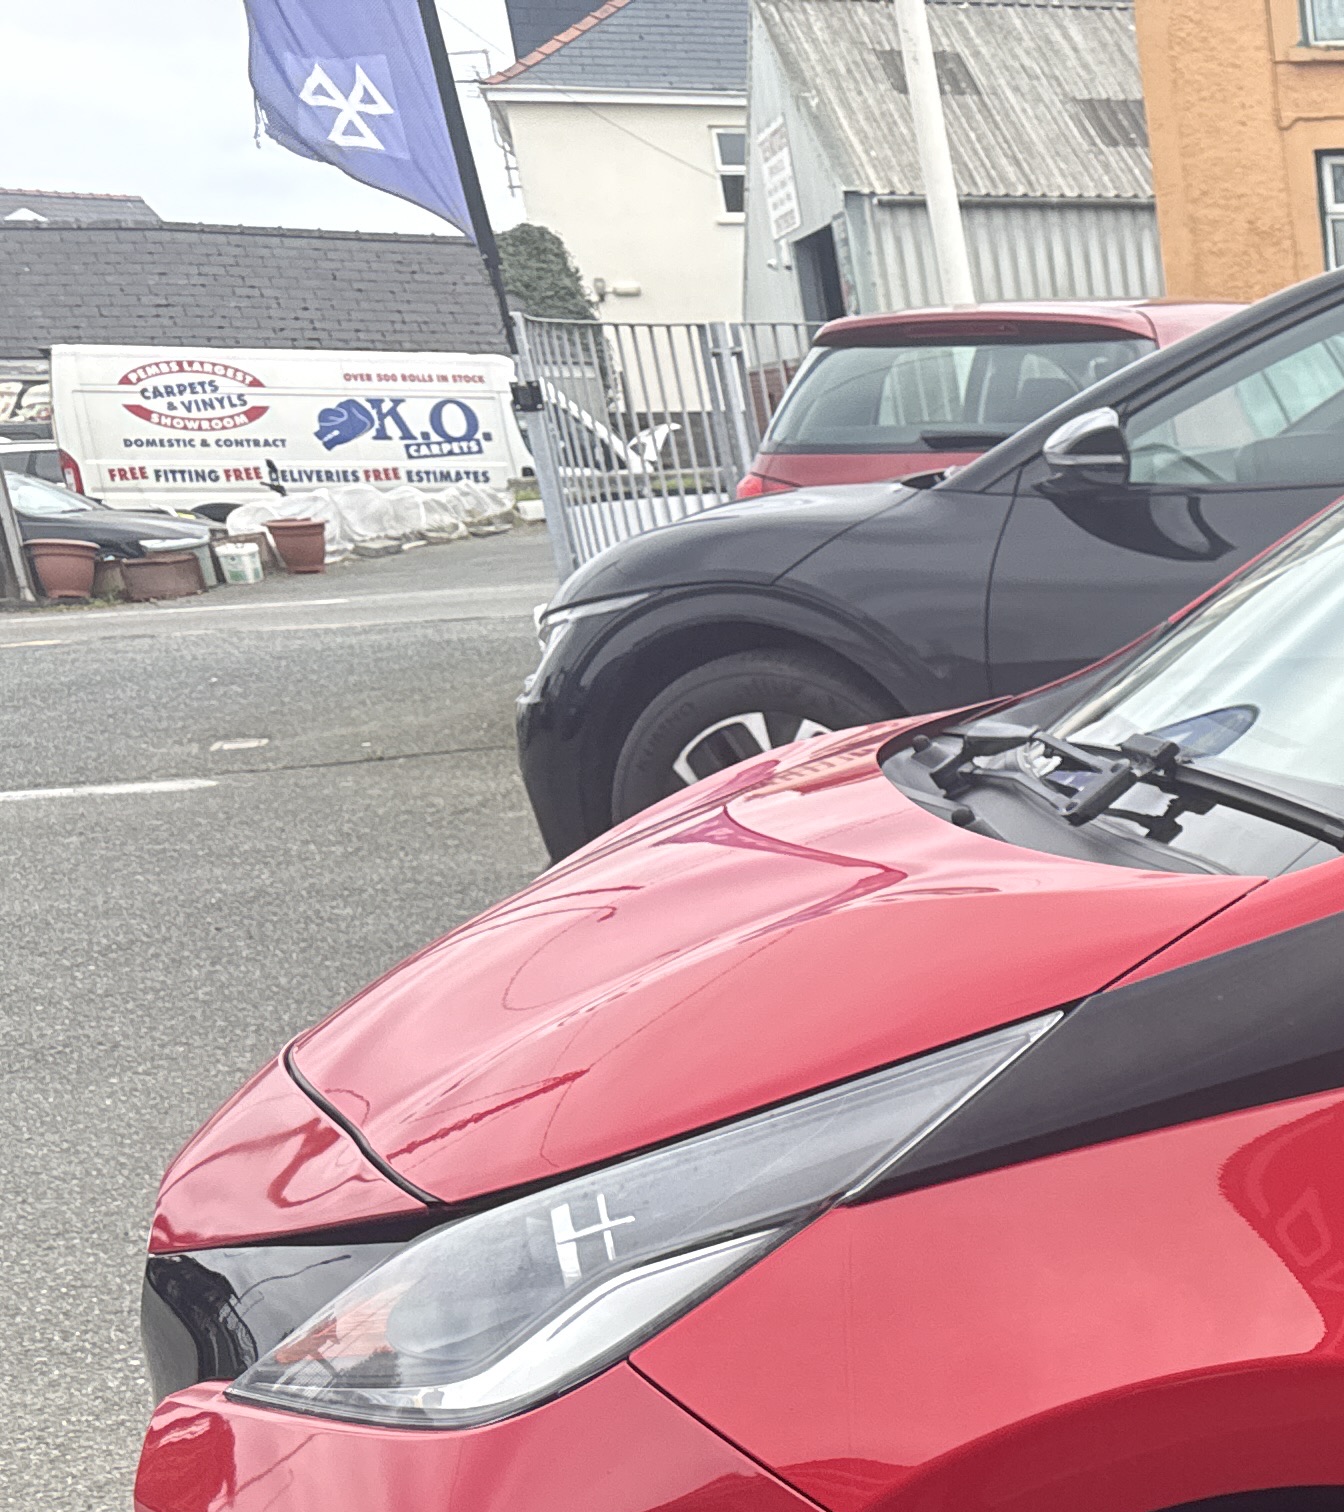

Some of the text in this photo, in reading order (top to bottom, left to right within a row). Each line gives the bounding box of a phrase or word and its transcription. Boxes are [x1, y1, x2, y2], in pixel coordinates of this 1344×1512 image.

[127, 361, 254, 385] PEMBS LARGEST
[343, 373, 486, 384] OVER 500 ROLLS IN STOCK
[140, 380, 220, 400] CARPETS
[167, 394, 248, 413] & VINYLS
[151, 413, 249, 430] SHOWROOM
[123, 438, 287, 448] DOMESTIC & CONTRACT
[408, 440, 480, 457] CARPETS
[108, 466, 149, 482] FREE
[154, 469, 220, 483] FITTING
[223, 467, 263, 482] FREE
[363, 467, 401, 482] FREE
[406, 470, 490, 483] ESTIMATES
